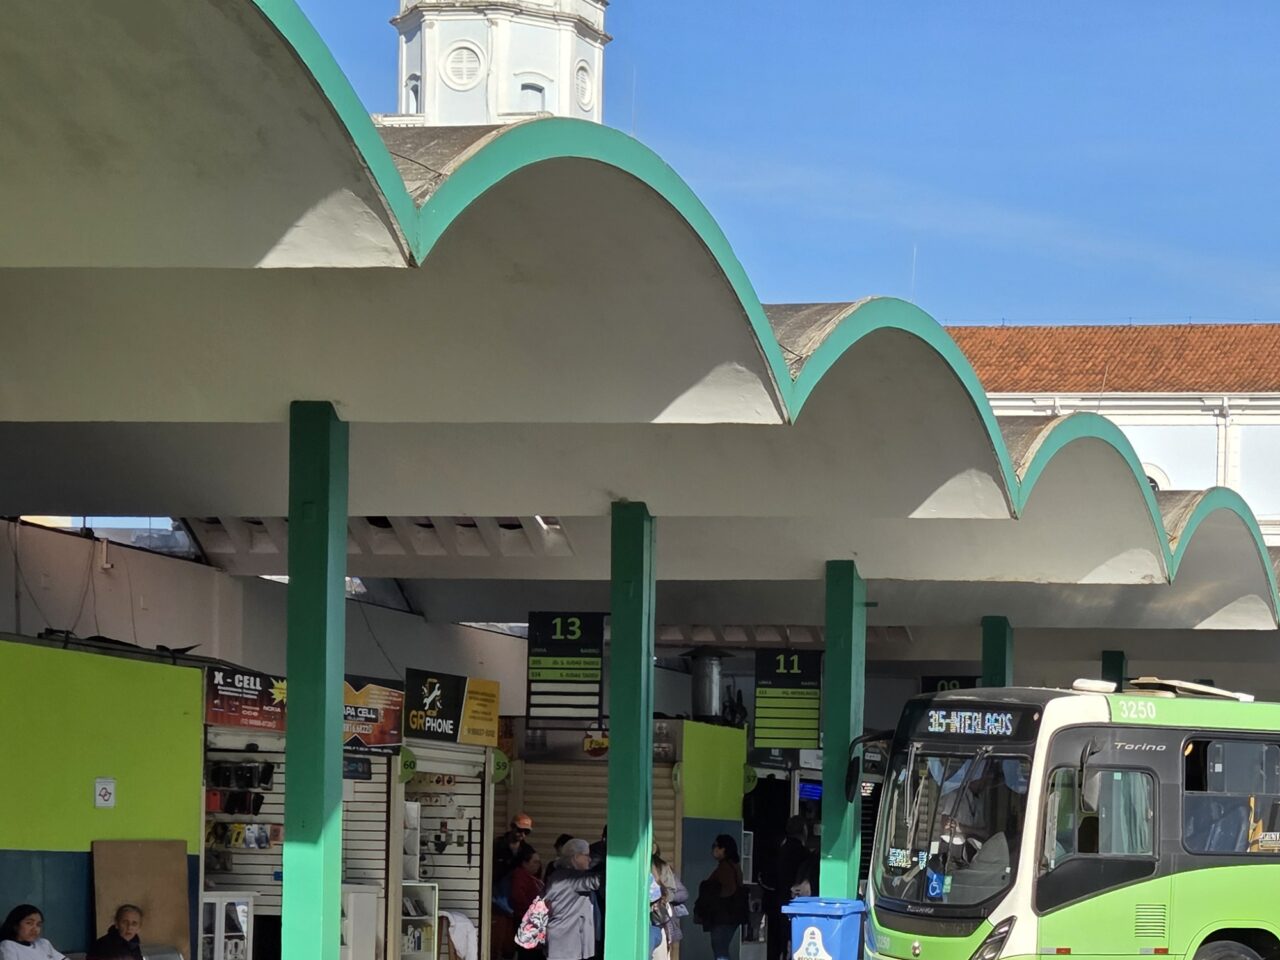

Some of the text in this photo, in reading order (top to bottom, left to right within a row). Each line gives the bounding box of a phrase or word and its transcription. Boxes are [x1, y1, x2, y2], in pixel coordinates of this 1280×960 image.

[552, 617, 582, 640] 13
[776, 654, 802, 674] 11
[214, 672, 224, 684] X
[234, 674, 262, 690] CELL
[1119, 701, 1156, 719] 3250
[1114, 742, 1167, 751] Torino
[403, 761, 416, 769] 60
[496, 762, 507, 770] 59
